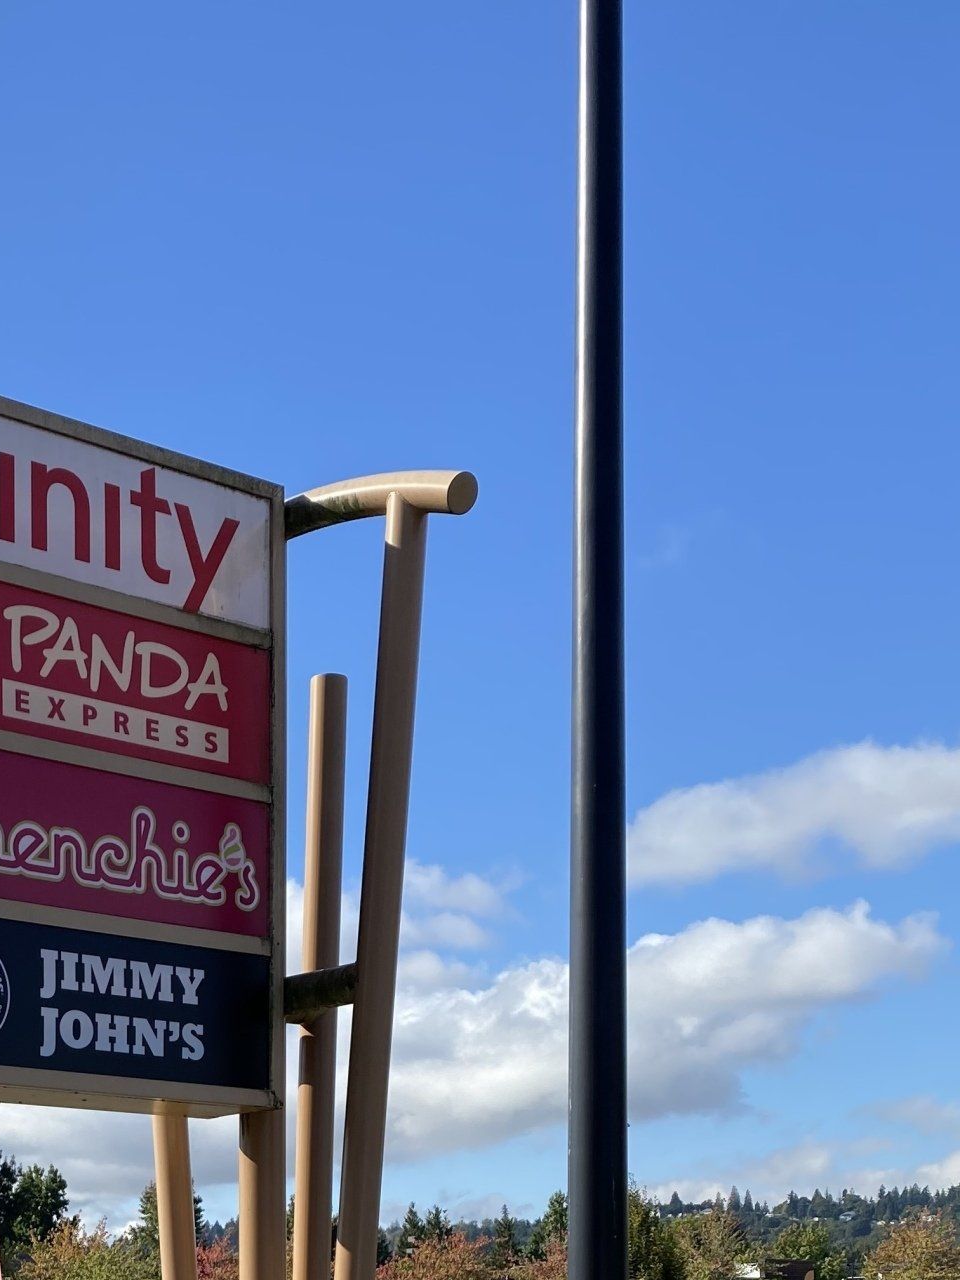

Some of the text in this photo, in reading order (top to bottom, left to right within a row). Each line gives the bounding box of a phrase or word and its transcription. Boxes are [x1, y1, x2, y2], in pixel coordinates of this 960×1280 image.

[3, 604, 228, 712] PANDA
[14, 688, 219, 754] EXPRESS
[40, 948, 205, 1006] JIMMY
[40, 1006, 205, 1061] JOHN'S
